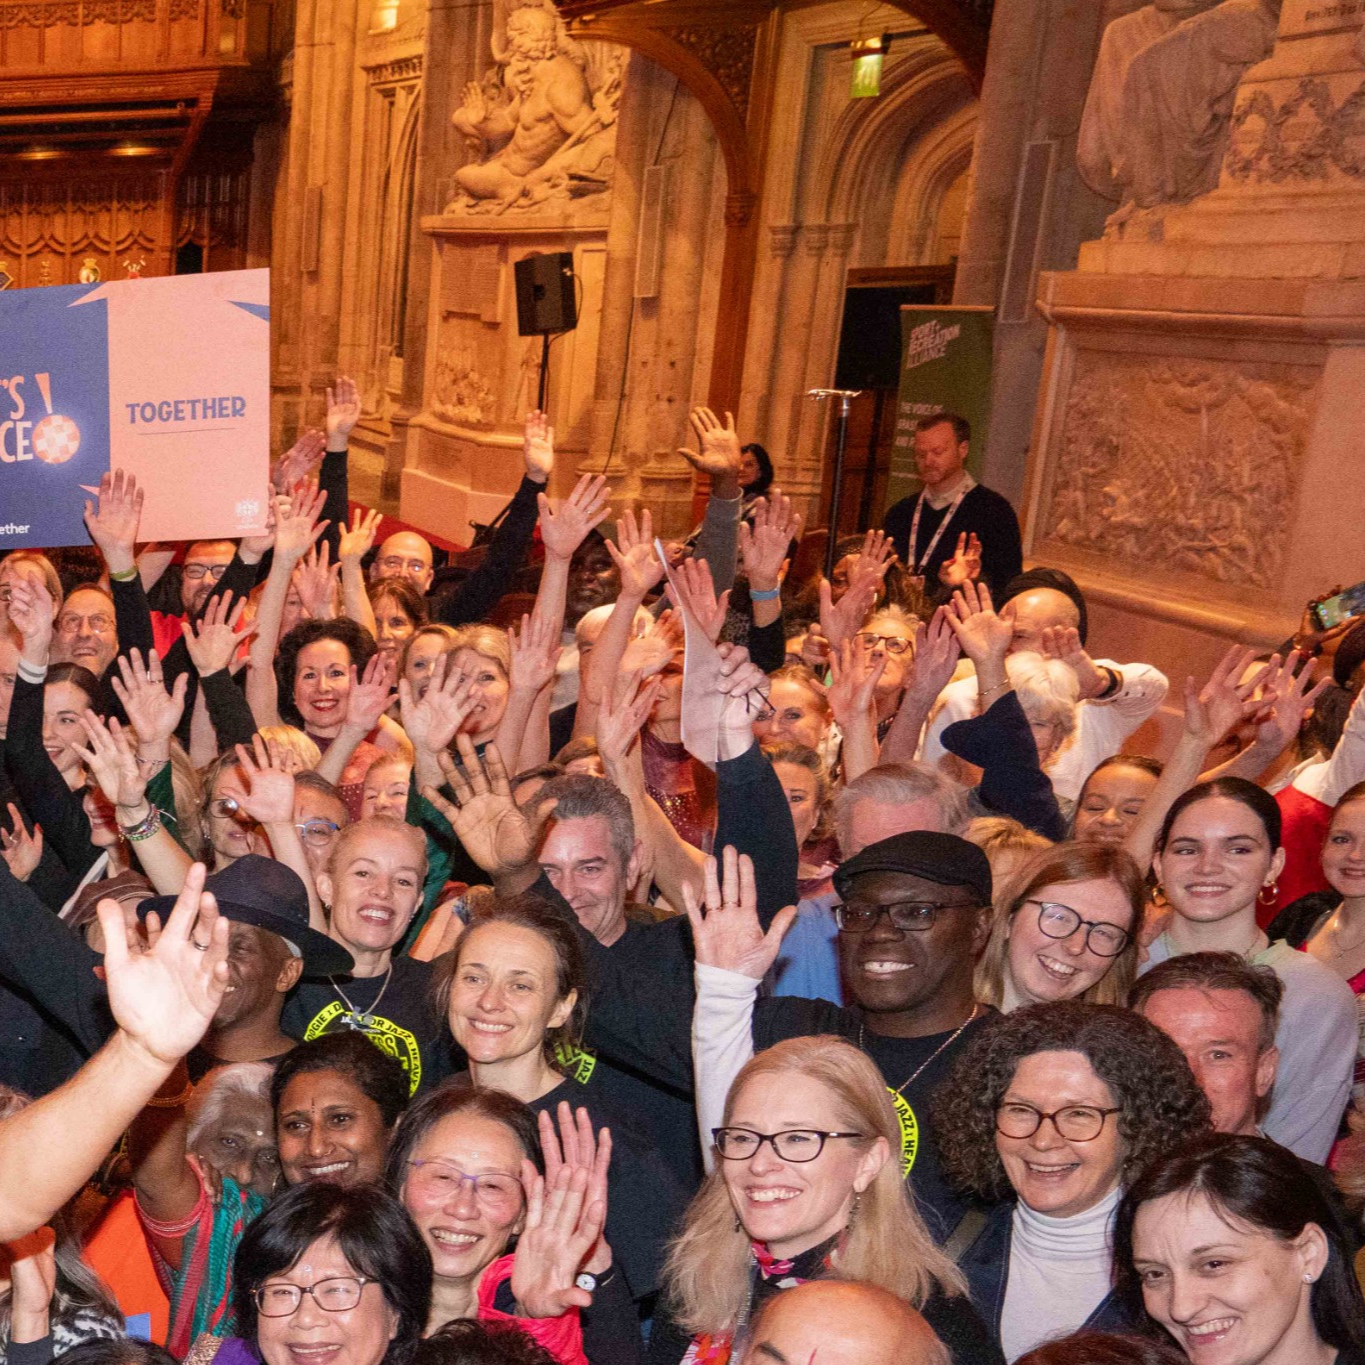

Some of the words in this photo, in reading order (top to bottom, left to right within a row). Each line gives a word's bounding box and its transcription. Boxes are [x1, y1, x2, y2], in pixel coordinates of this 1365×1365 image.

[125, 396, 246, 424] TOGETHER
[307, 1014, 328, 1041] OOGIE
[896, 1103, 915, 1131] JAZZ
